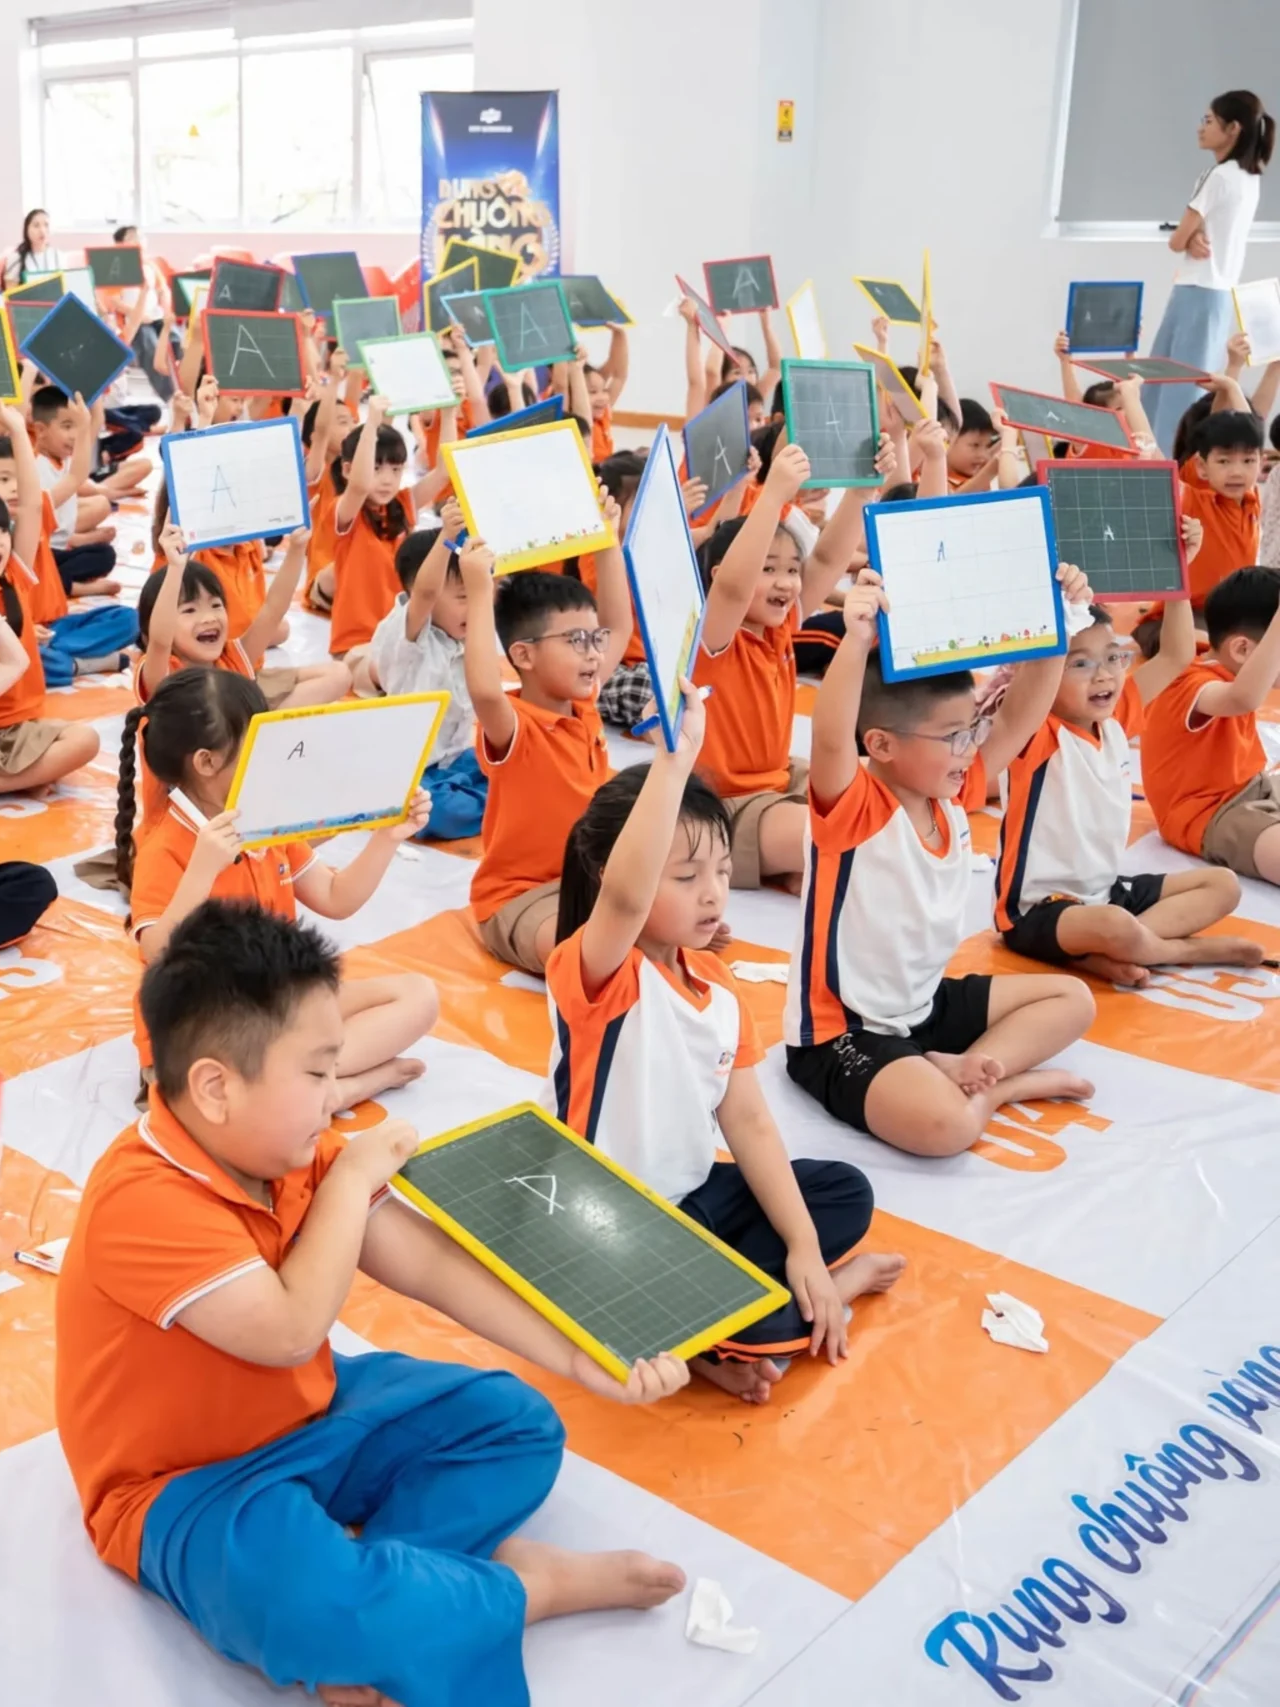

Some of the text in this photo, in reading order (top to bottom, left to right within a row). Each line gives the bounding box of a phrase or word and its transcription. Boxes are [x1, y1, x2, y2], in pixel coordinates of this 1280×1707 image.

[219, 284, 232, 301] A
[732, 264, 760, 299] A
[519, 301, 549, 351] A
[229, 324, 275, 378] A
[818, 395, 846, 450] A
[712, 435, 732, 489] A
[211, 465, 237, 513] A
[937, 541, 946, 562] A
[1103, 524, 1115, 541] A
[504, 1174, 565, 1215] A
[924, 1558, 1127, 1702] Rung
[1071, 1424, 1261, 1574] chuông
